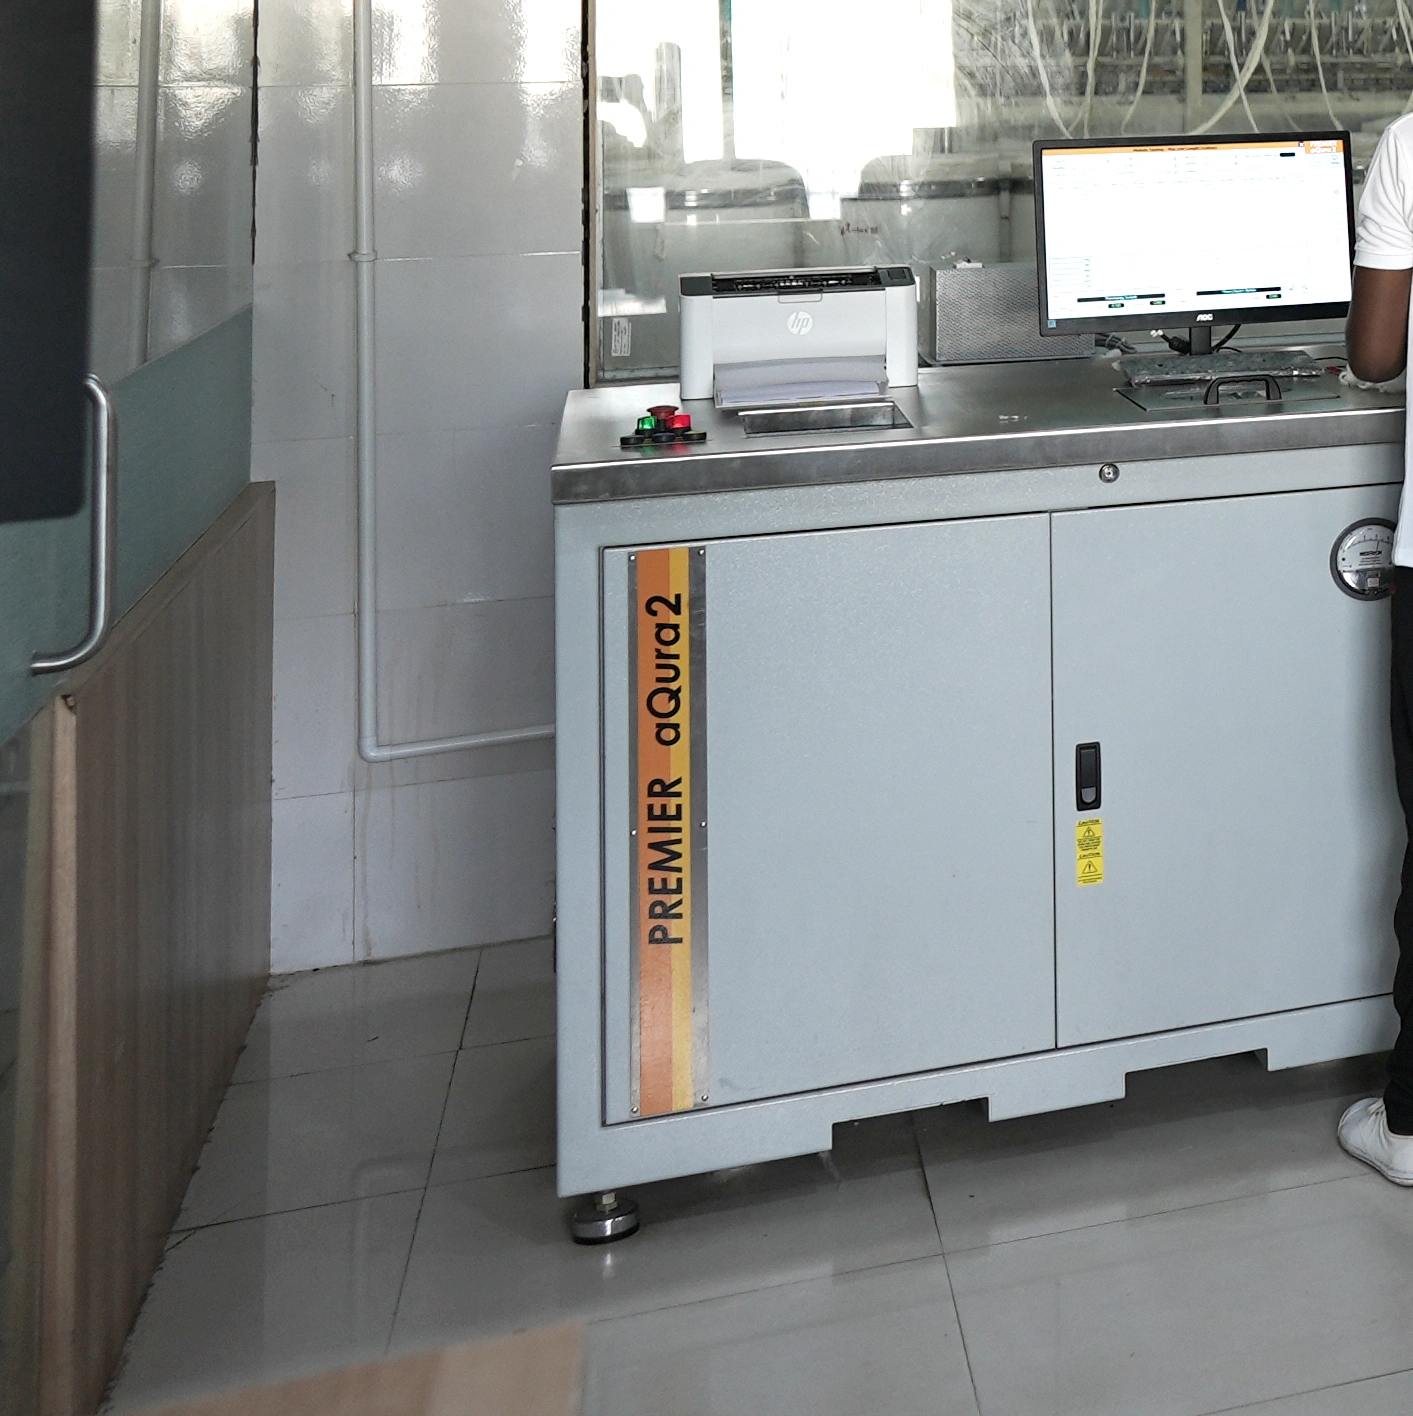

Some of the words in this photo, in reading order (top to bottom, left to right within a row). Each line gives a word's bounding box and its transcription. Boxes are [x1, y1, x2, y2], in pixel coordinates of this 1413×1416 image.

[790, 312, 811, 334] hp
[645, 592, 683, 746] aQura2
[647, 776, 684, 945] PREMIER
